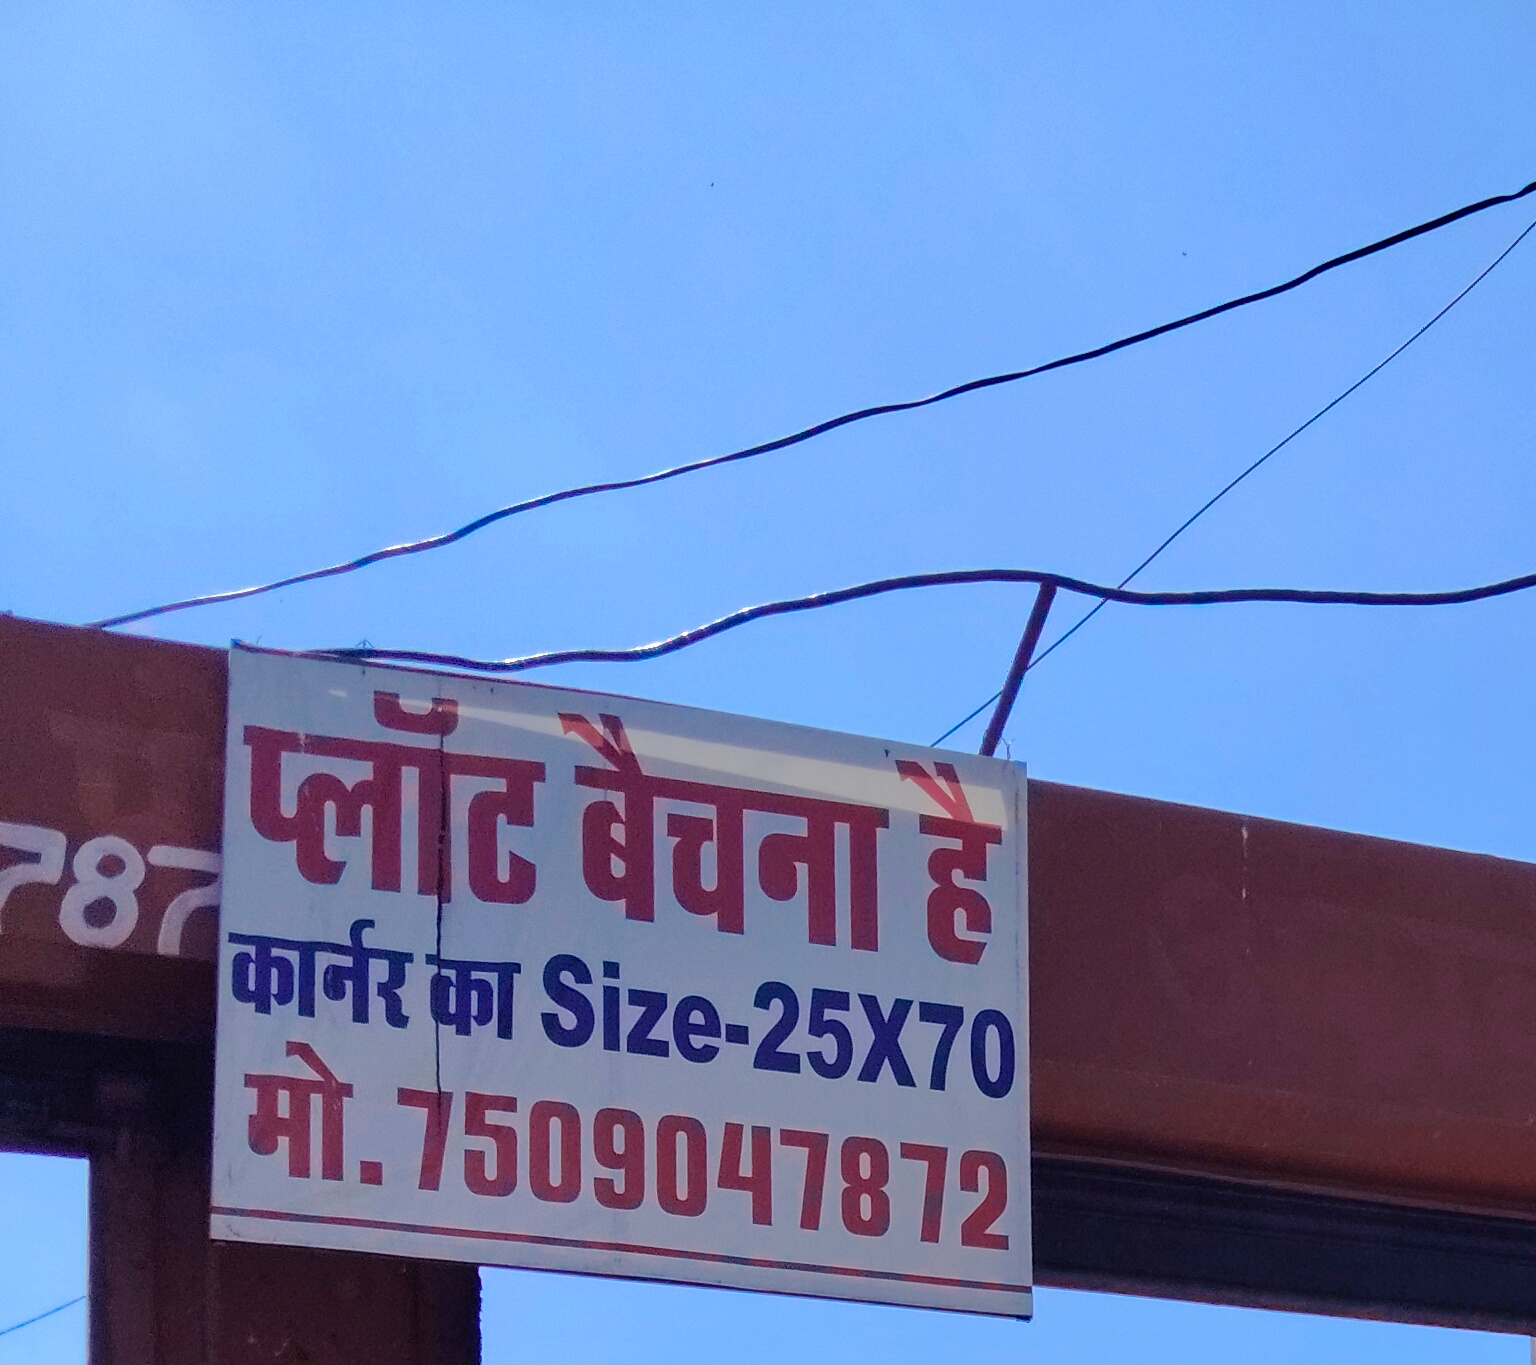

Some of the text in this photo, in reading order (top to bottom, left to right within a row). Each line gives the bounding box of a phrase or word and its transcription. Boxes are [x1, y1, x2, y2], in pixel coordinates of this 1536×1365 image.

[243, 691, 546, 906] प्लॉट
[895, 759, 1003, 965] है
[428, 957, 521, 1040] का
[541, 954, 1016, 1100] Size-25X70
[397, 1088, 1010, 1250] 7509047872
